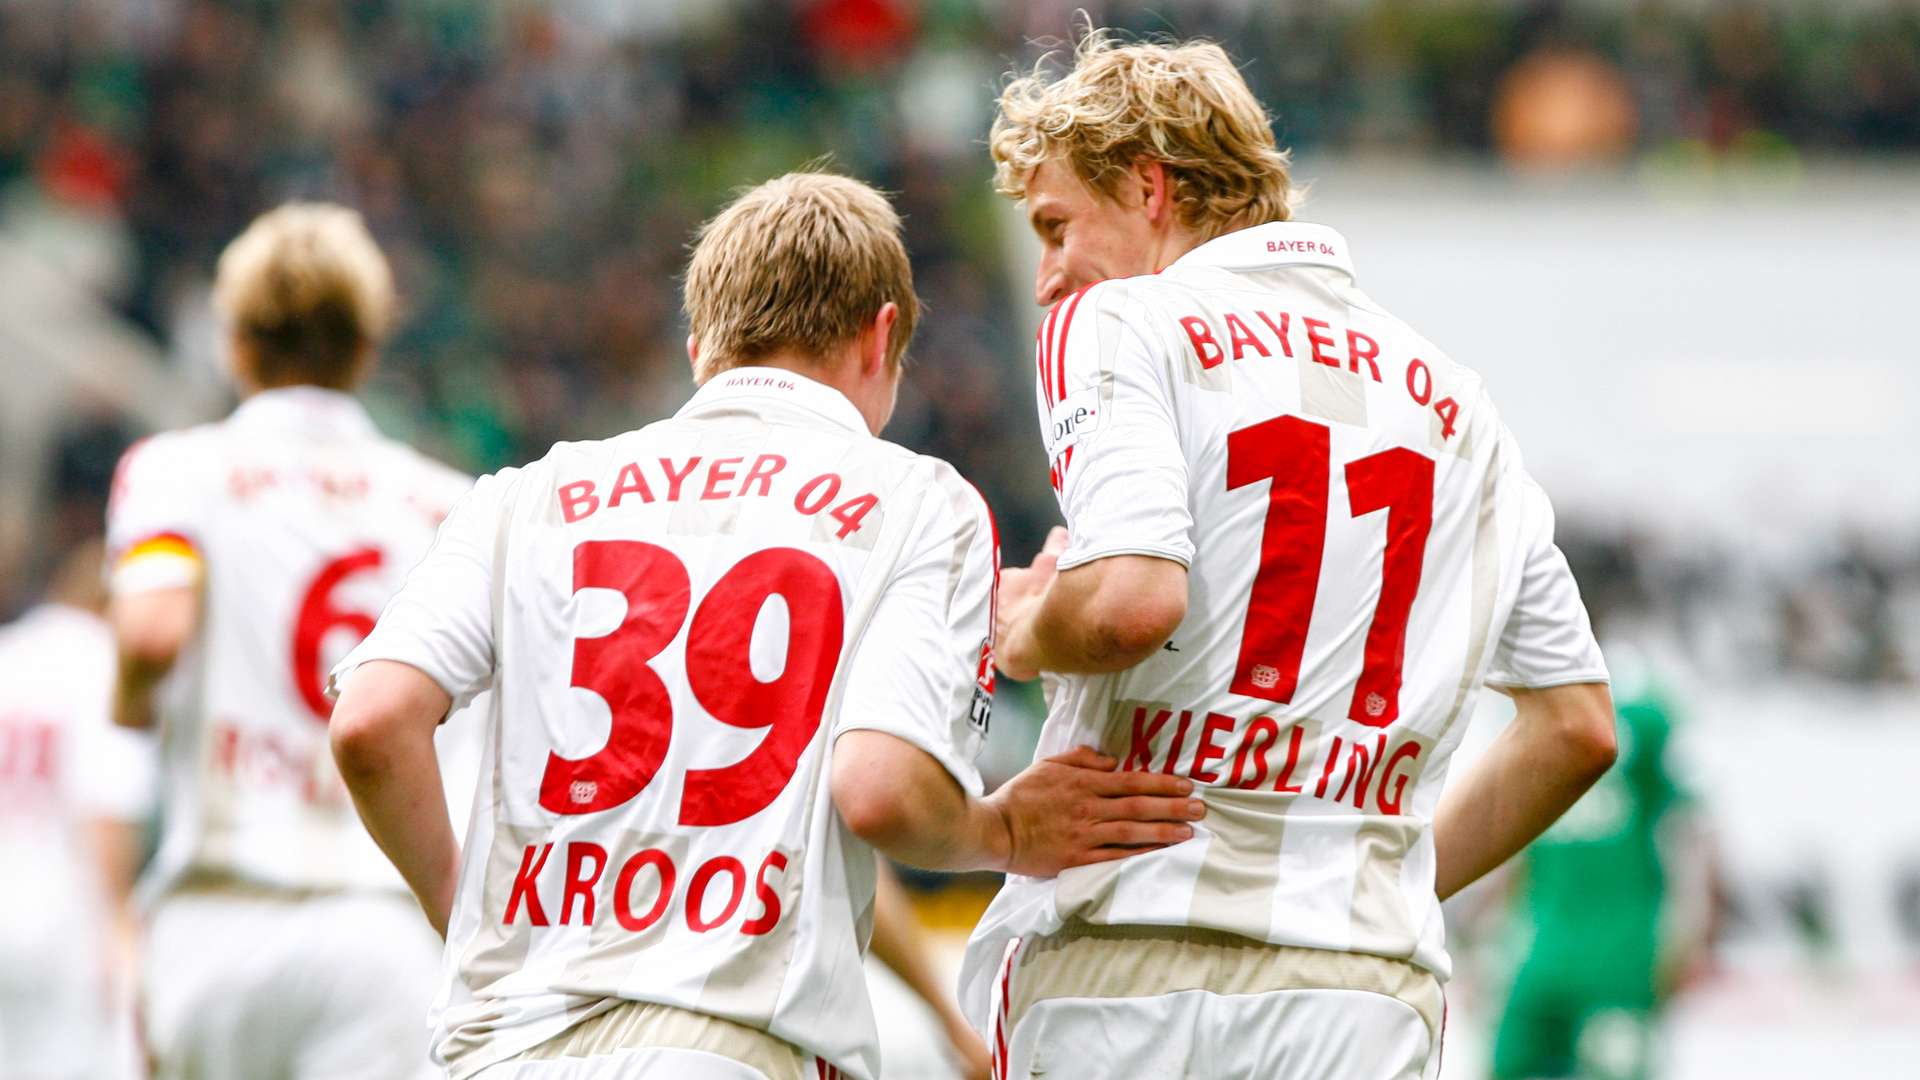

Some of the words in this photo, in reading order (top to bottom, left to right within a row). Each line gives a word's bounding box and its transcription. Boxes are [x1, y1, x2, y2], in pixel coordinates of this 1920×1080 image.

[1266, 240, 1315, 252] BAYER
[1319, 243, 1335, 256] 04
[726, 376, 775, 387] BAYER
[778, 379, 796, 391] 04
[1179, 310, 1383, 383] BAYER
[1405, 357, 1460, 441] 04
[558, 454, 787, 524] BAYER
[793, 472, 880, 540] 04
[1226, 413, 1436, 729] 11
[290, 546, 383, 722] 6
[538, 540, 844, 827] 39
[502, 840, 789, 936] KROOS
